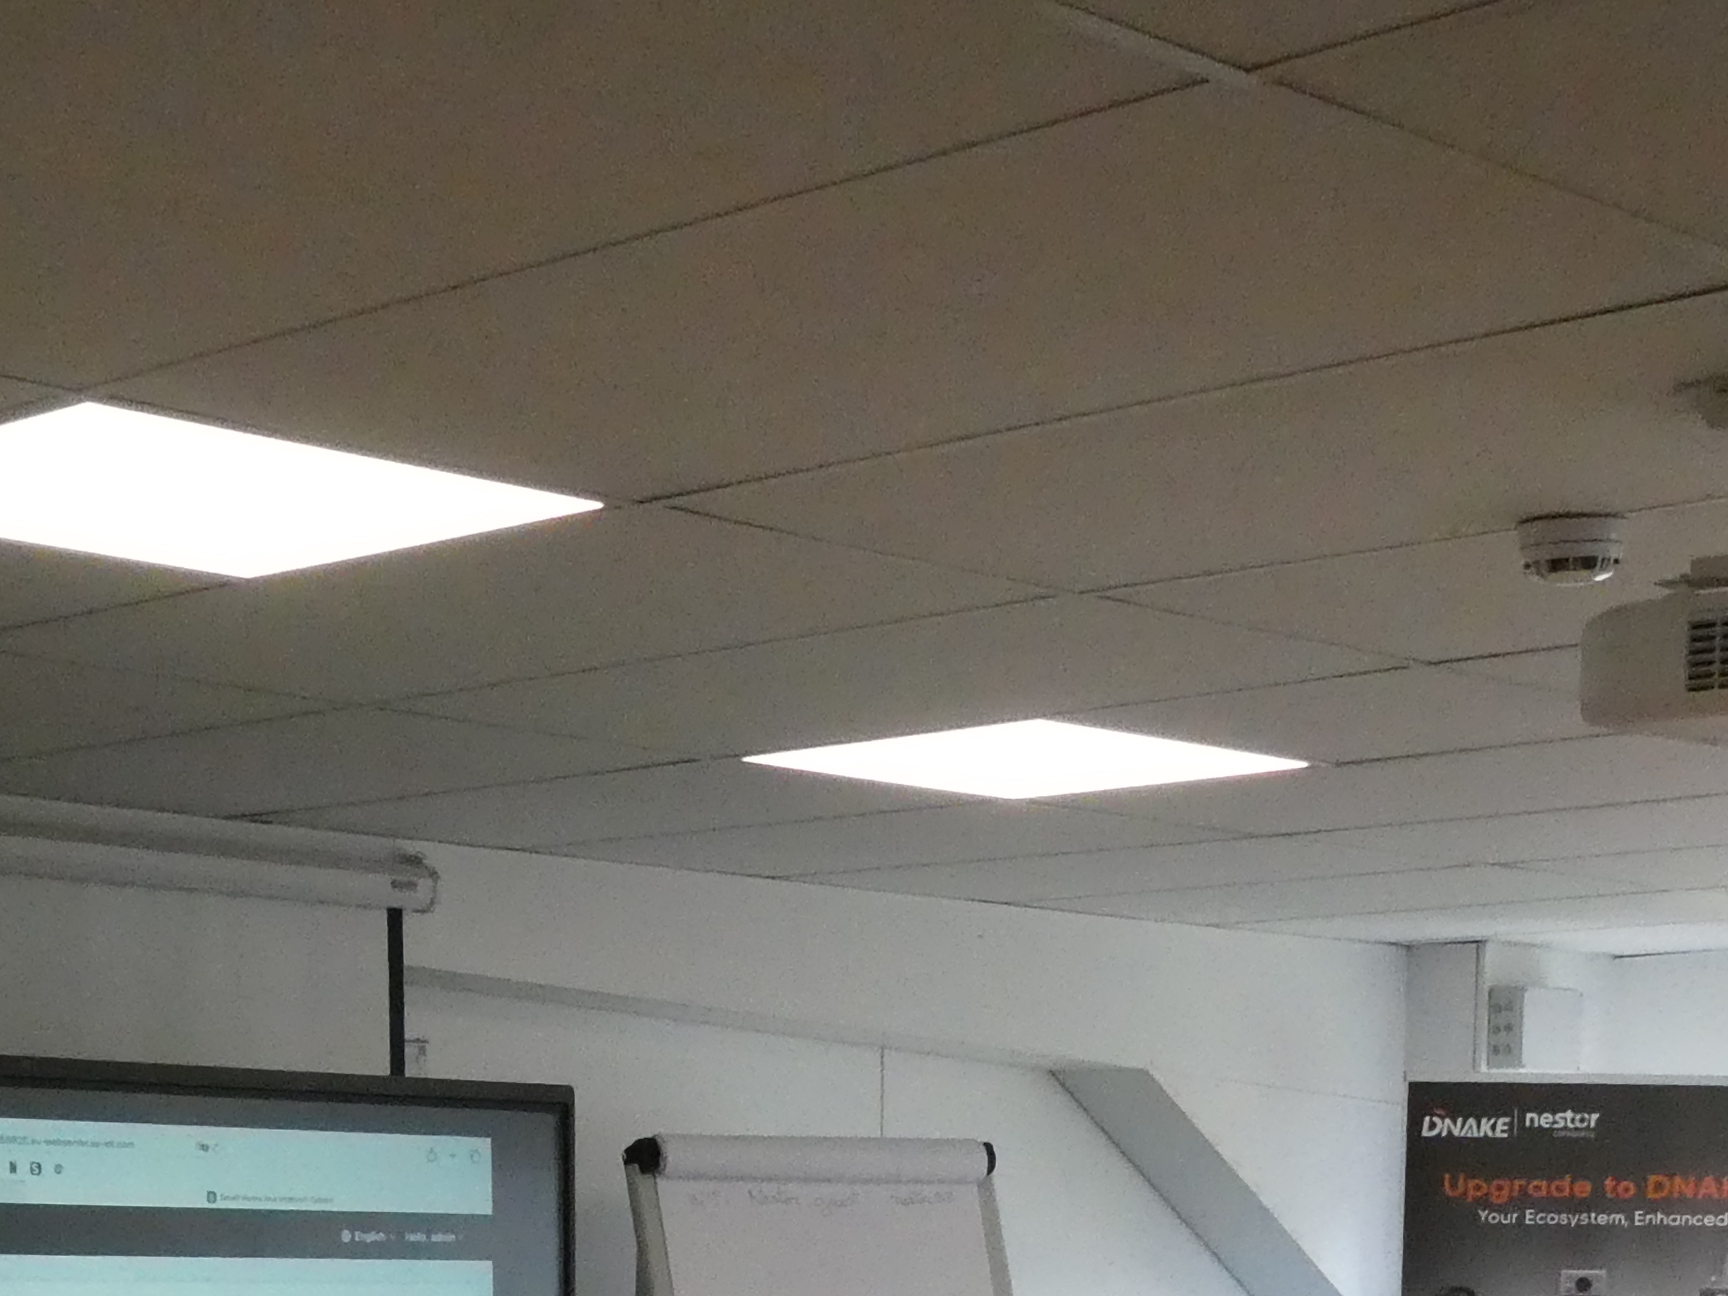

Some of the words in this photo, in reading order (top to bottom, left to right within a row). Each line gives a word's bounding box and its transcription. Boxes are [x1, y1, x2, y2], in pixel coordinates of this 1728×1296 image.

[1422, 1109, 1510, 1138] DNAKE
[1525, 1110, 1600, 1129] nestor
[1443, 1173, 1592, 1203] Upgrade
[1604, 1175, 1636, 1199] to
[1478, 1209, 1518, 1225] Your
[1525, 1210, 1629, 1227] Ecosystem,
[1634, 1211, 1728, 1227] Enhanced
